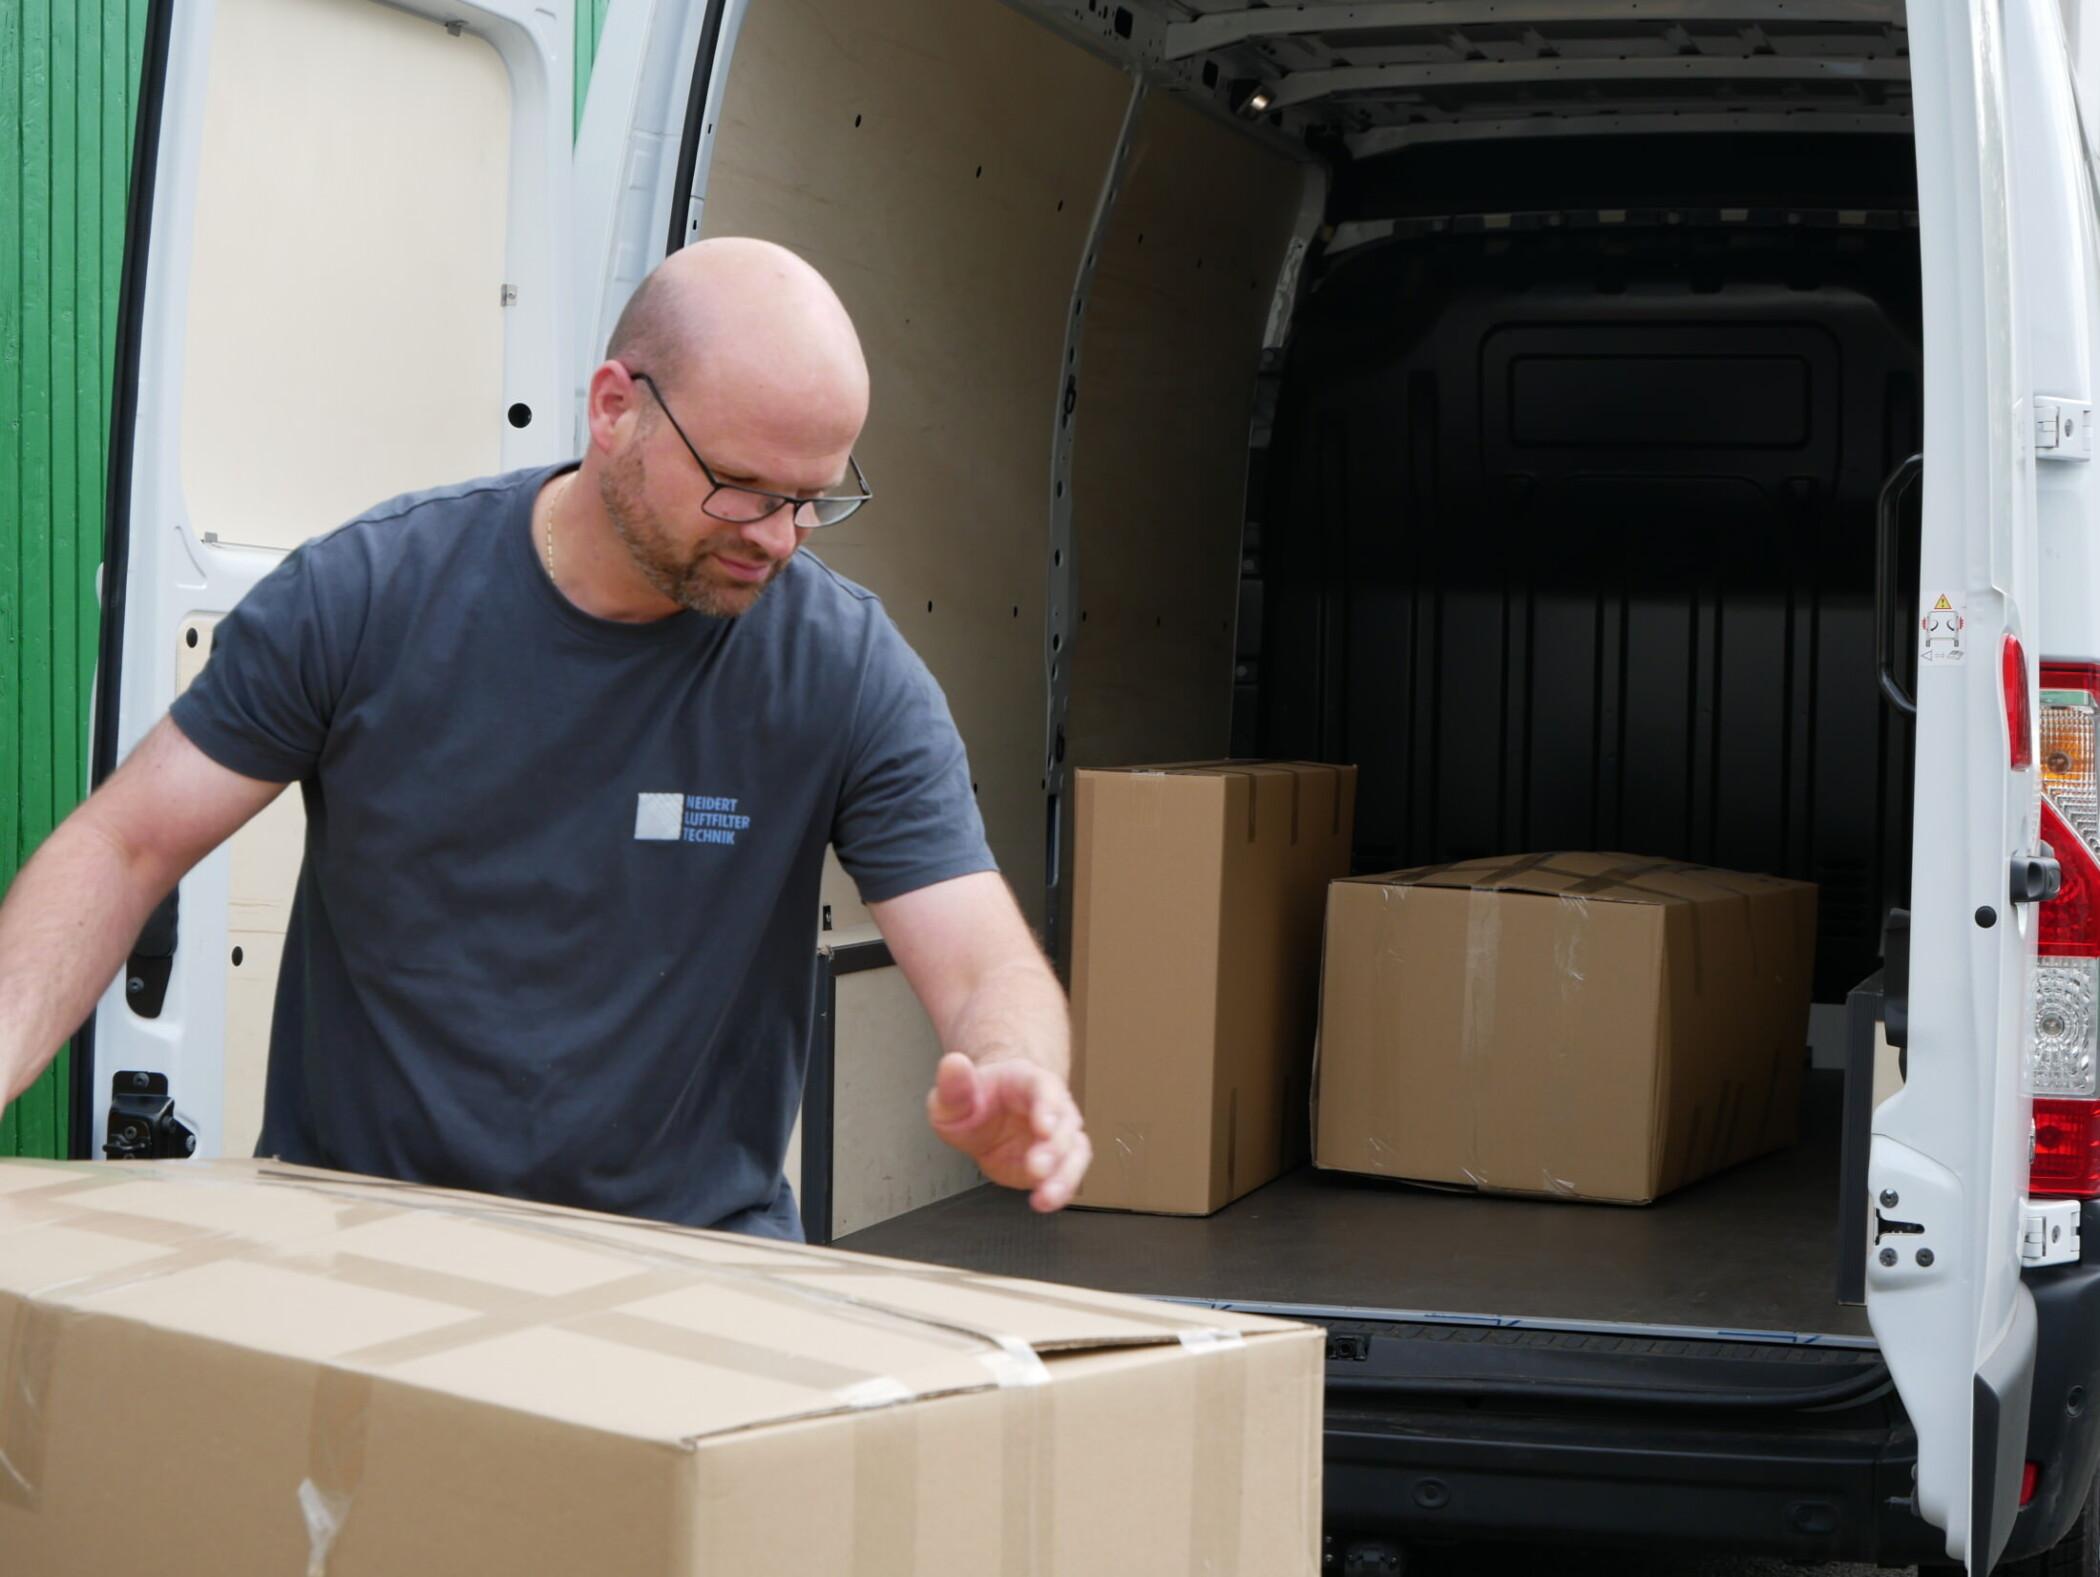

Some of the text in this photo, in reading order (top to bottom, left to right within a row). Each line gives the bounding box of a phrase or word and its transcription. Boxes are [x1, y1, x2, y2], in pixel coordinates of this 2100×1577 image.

[686, 795, 738, 812] NEIDERT
[684, 811, 751, 829] LUFTFILTER
[683, 827, 735, 845] TECHNIK
